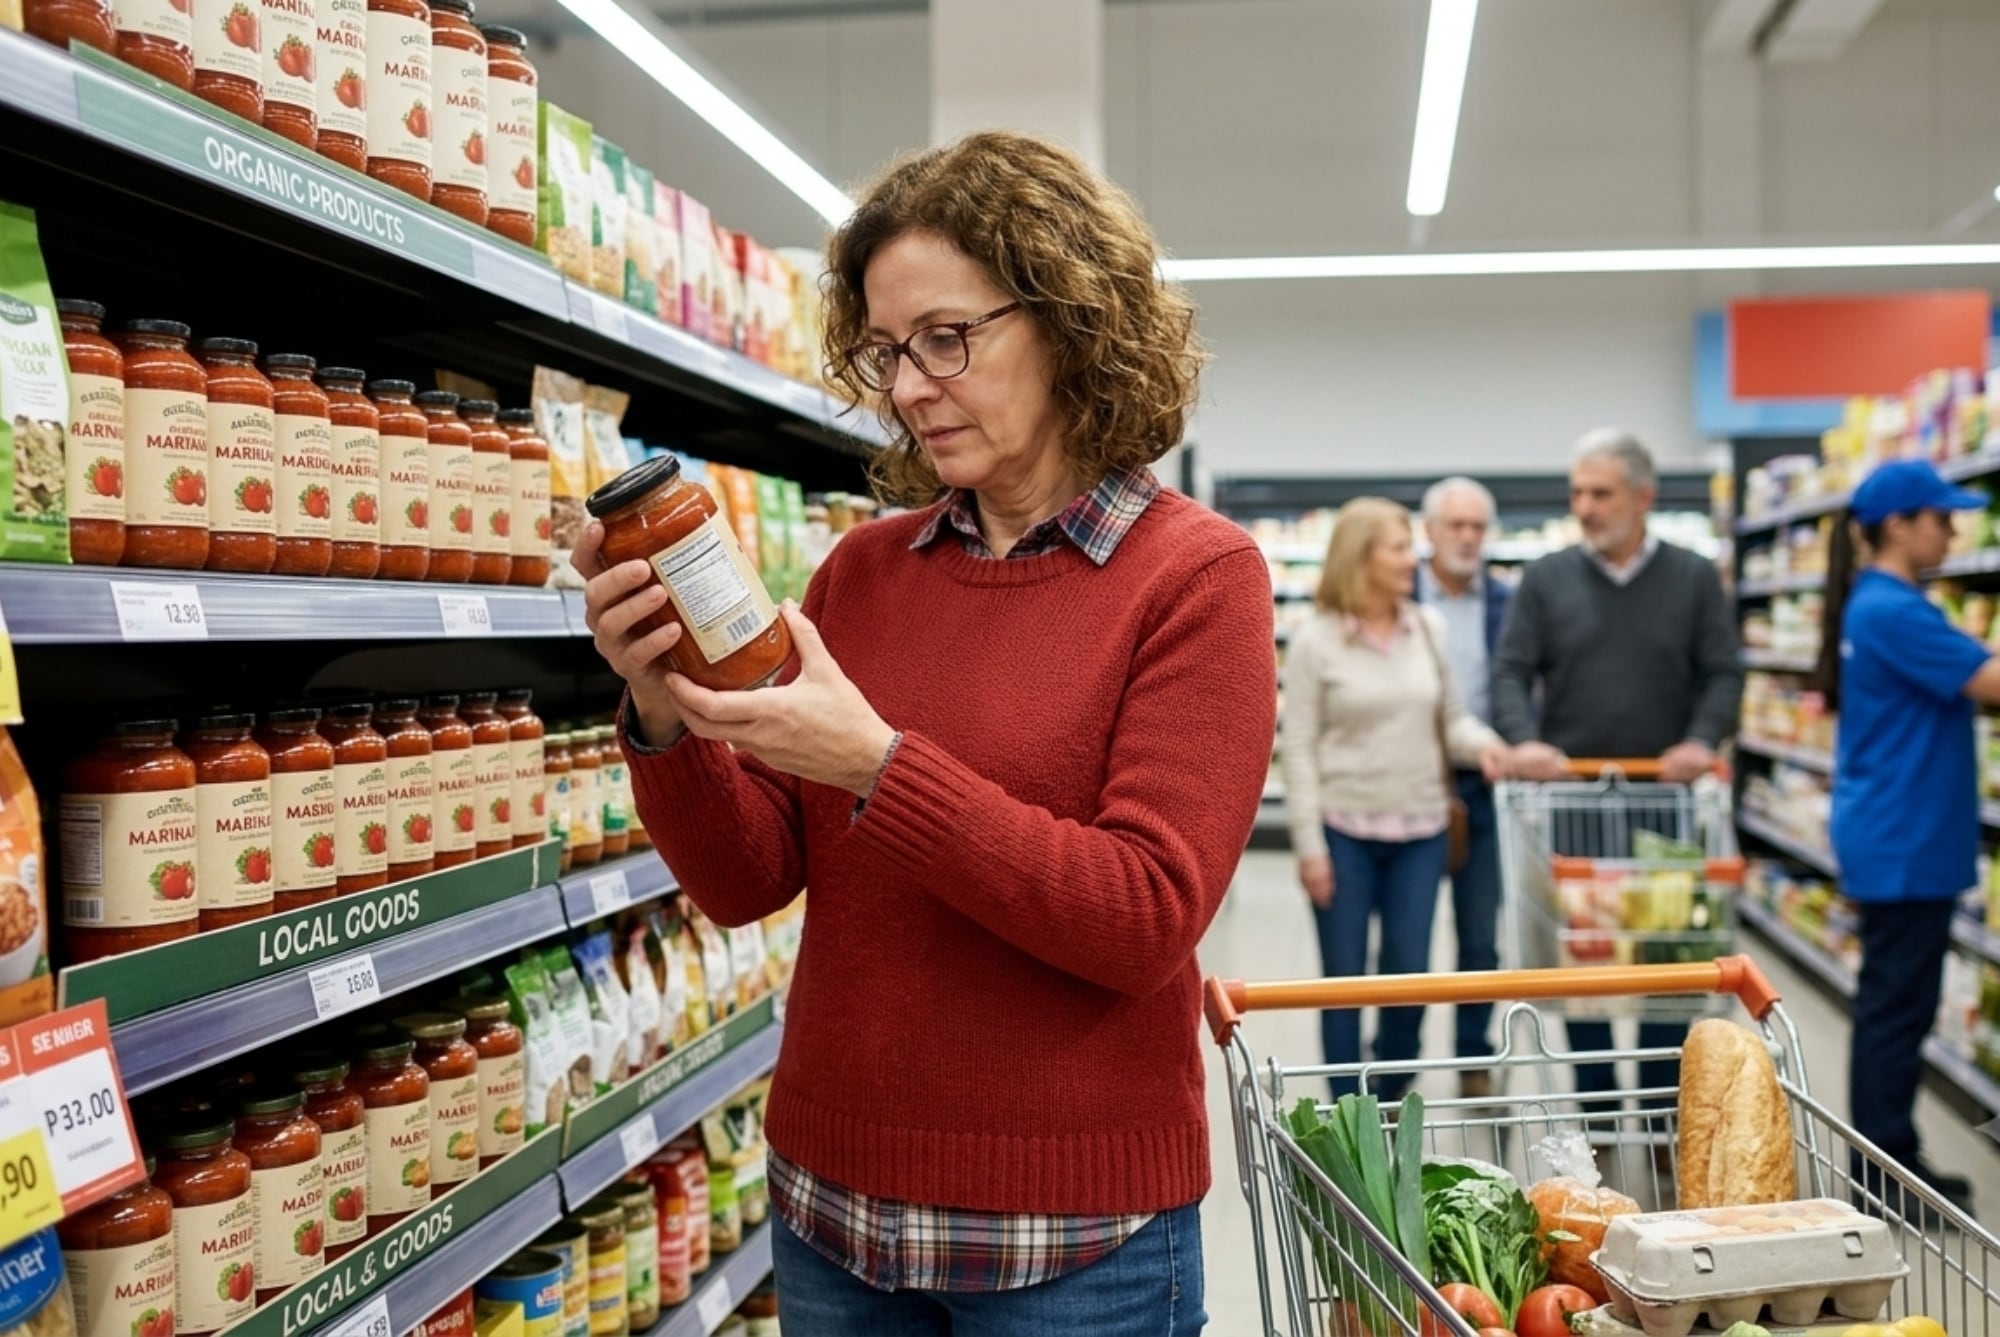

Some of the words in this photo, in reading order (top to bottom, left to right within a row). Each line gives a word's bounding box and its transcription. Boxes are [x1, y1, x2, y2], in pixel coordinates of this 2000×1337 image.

[204, 137, 305, 204] ORGANIC
[308, 179, 405, 244] PRODUCTS
[259, 912, 339, 966] LOCAL
[345, 888, 419, 939] GOODS
[283, 1266, 357, 1337] LOCAL
[360, 1252, 377, 1287] &
[384, 1203, 453, 1270] GOODS
